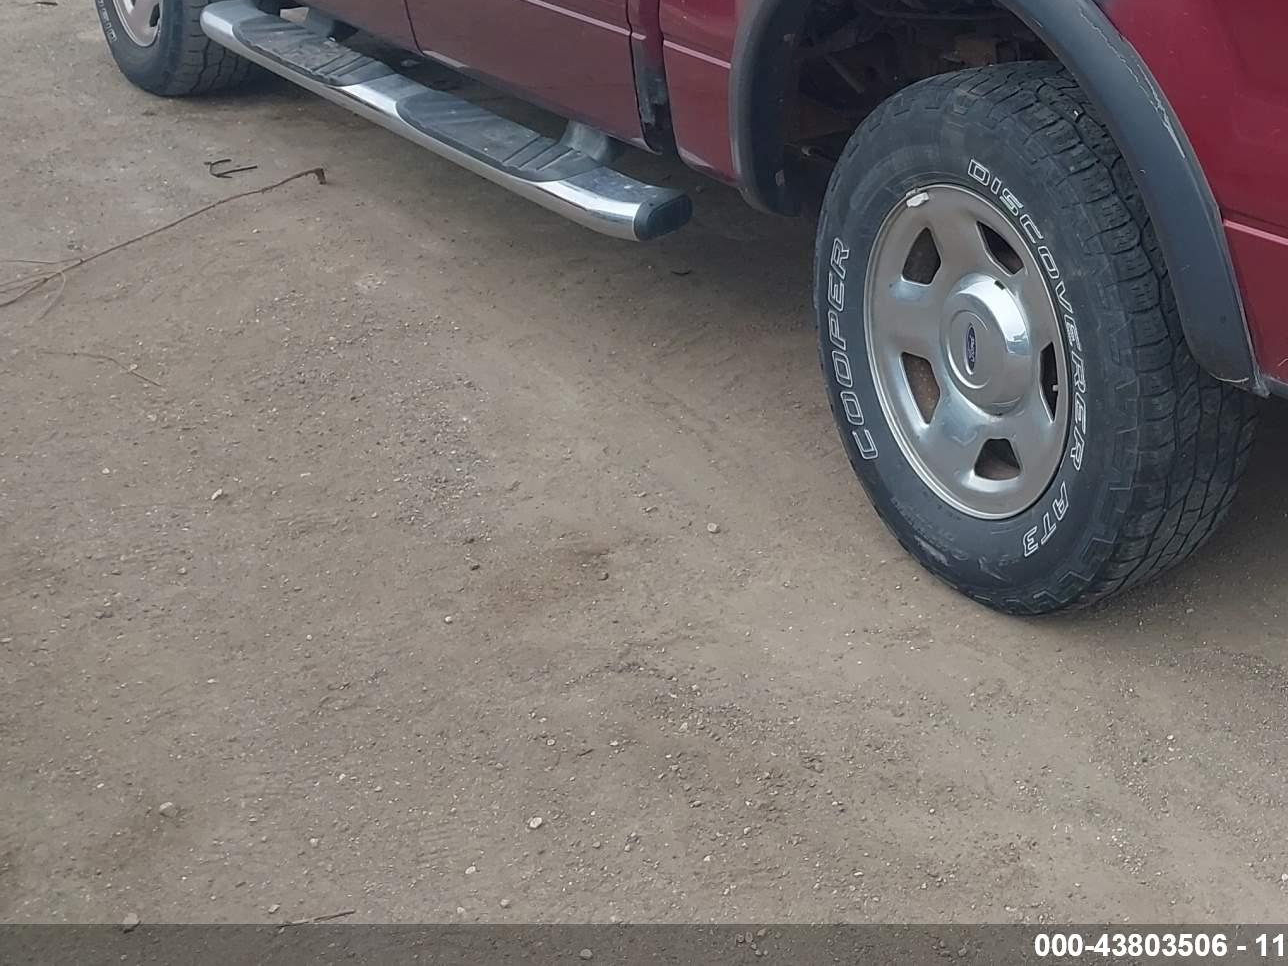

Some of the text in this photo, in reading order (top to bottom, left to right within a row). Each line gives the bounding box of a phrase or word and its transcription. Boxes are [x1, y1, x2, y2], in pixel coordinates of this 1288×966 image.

[828, 237, 879, 460] COOPER
[967, 159, 1088, 557] DISCOVERER AT3
